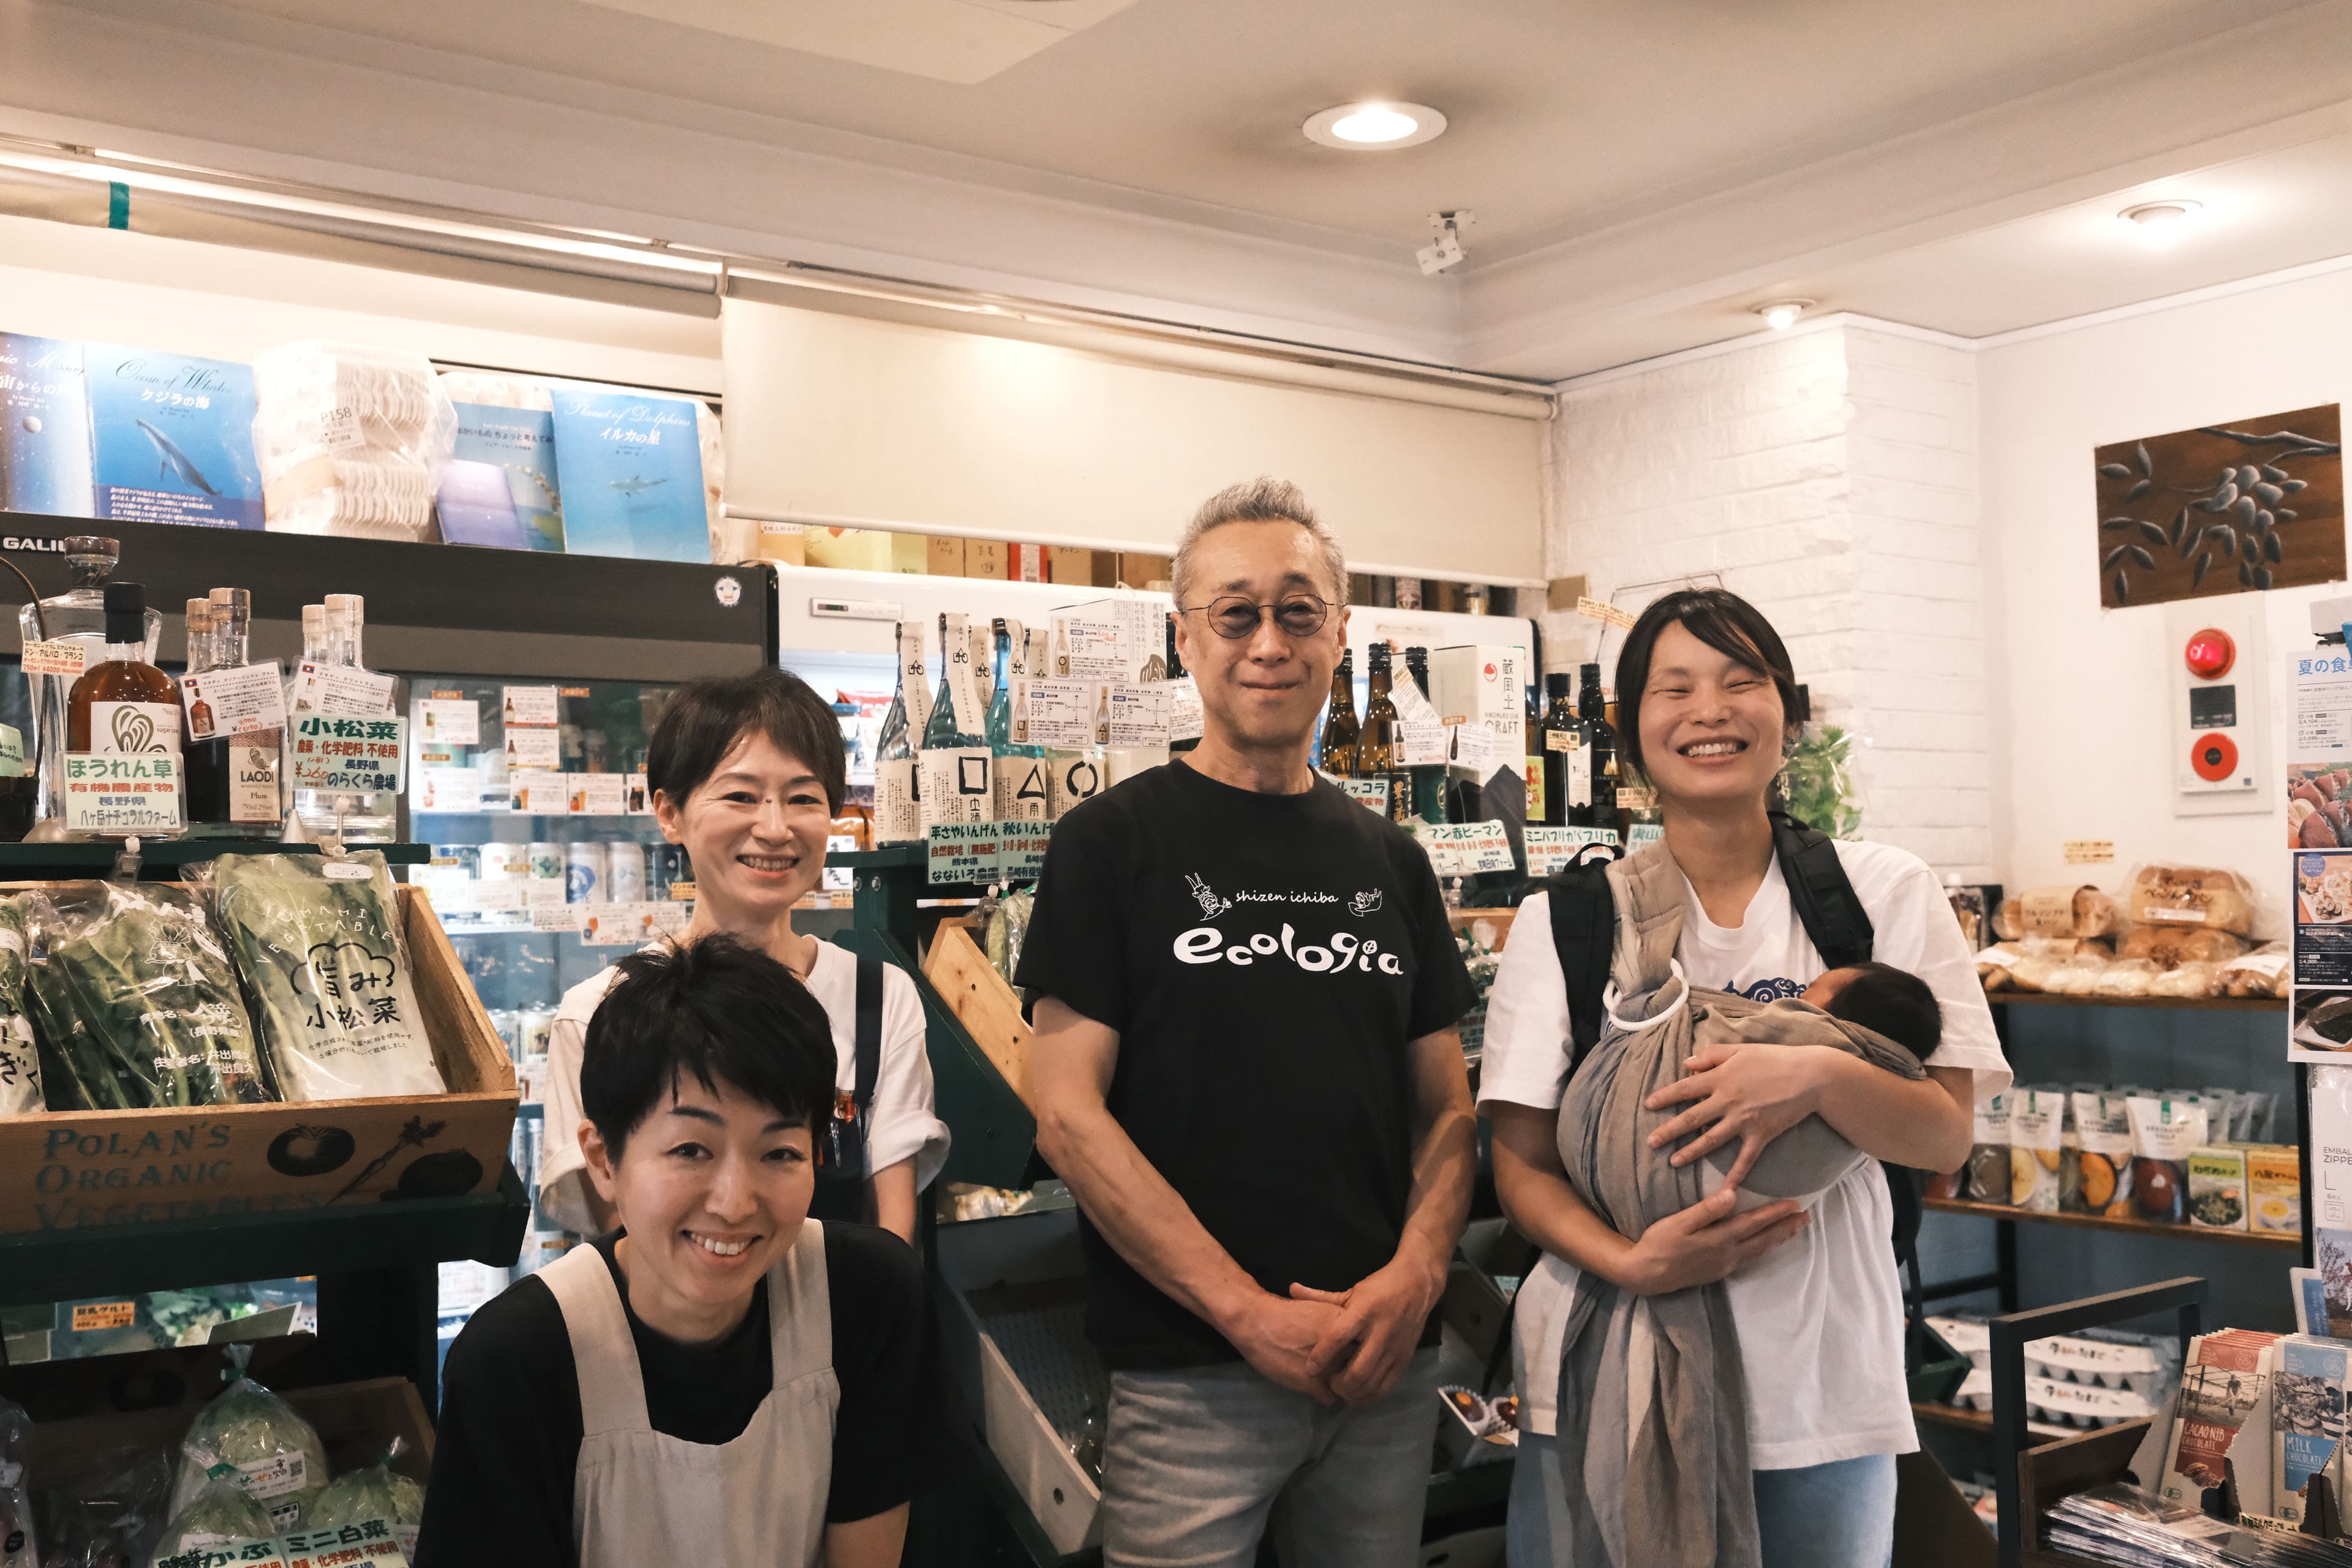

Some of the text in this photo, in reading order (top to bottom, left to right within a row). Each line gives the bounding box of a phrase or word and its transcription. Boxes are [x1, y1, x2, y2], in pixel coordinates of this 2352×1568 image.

[116, 358, 232, 393] Ocean of Whales
[141, 388, 211, 410] クジラの海
[565, 398, 692, 428] Planet of Dolphins
[599, 427, 661, 446] イルカの星
[1502, 658, 1515, 710] 蔵風土
[300, 717, 399, 741] 小松菜
[297, 739, 399, 759] 農薬・化学肥料 不使用
[67, 758, 173, 778] ほうれん草
[344, 758, 380, 771] 長野県
[240, 771, 274, 783] LAODI
[327, 772, 397, 791] のらくら農場
[69, 782, 174, 793] 有機農産物
[1336, 781, 1386, 794] ルッコラ
[98, 796, 147, 806] 長野県
[931, 824, 998, 840] 平さやいんげん
[1002, 821, 1057, 836] 秋いんげ
[1632, 829, 1664, 840] 実山
[951, 857, 979, 867] 熊本県
[932, 867, 999, 882] なないろ農園
[1235, 889, 1339, 904] shizen ichiba
[256, 920, 393, 964] VEGETABLE
[1172, 922, 1404, 976] ecologia
[306, 995, 402, 1030] 小松菜
[43, 1122, 232, 1159] POLAN'S
[35, 1159, 235, 1195] ORGANIC
[2184, 1423, 2225, 1442] CACAO NIB
[2181, 1436, 2216, 1451] CHOCOLATE
[2286, 1436, 2313, 1454] MILK
[2286, 1452, 2323, 1467] CHOCOLATE
[285, 1519, 390, 1553] ミニ白菜
[363, 1540, 399, 1558] 不使用
